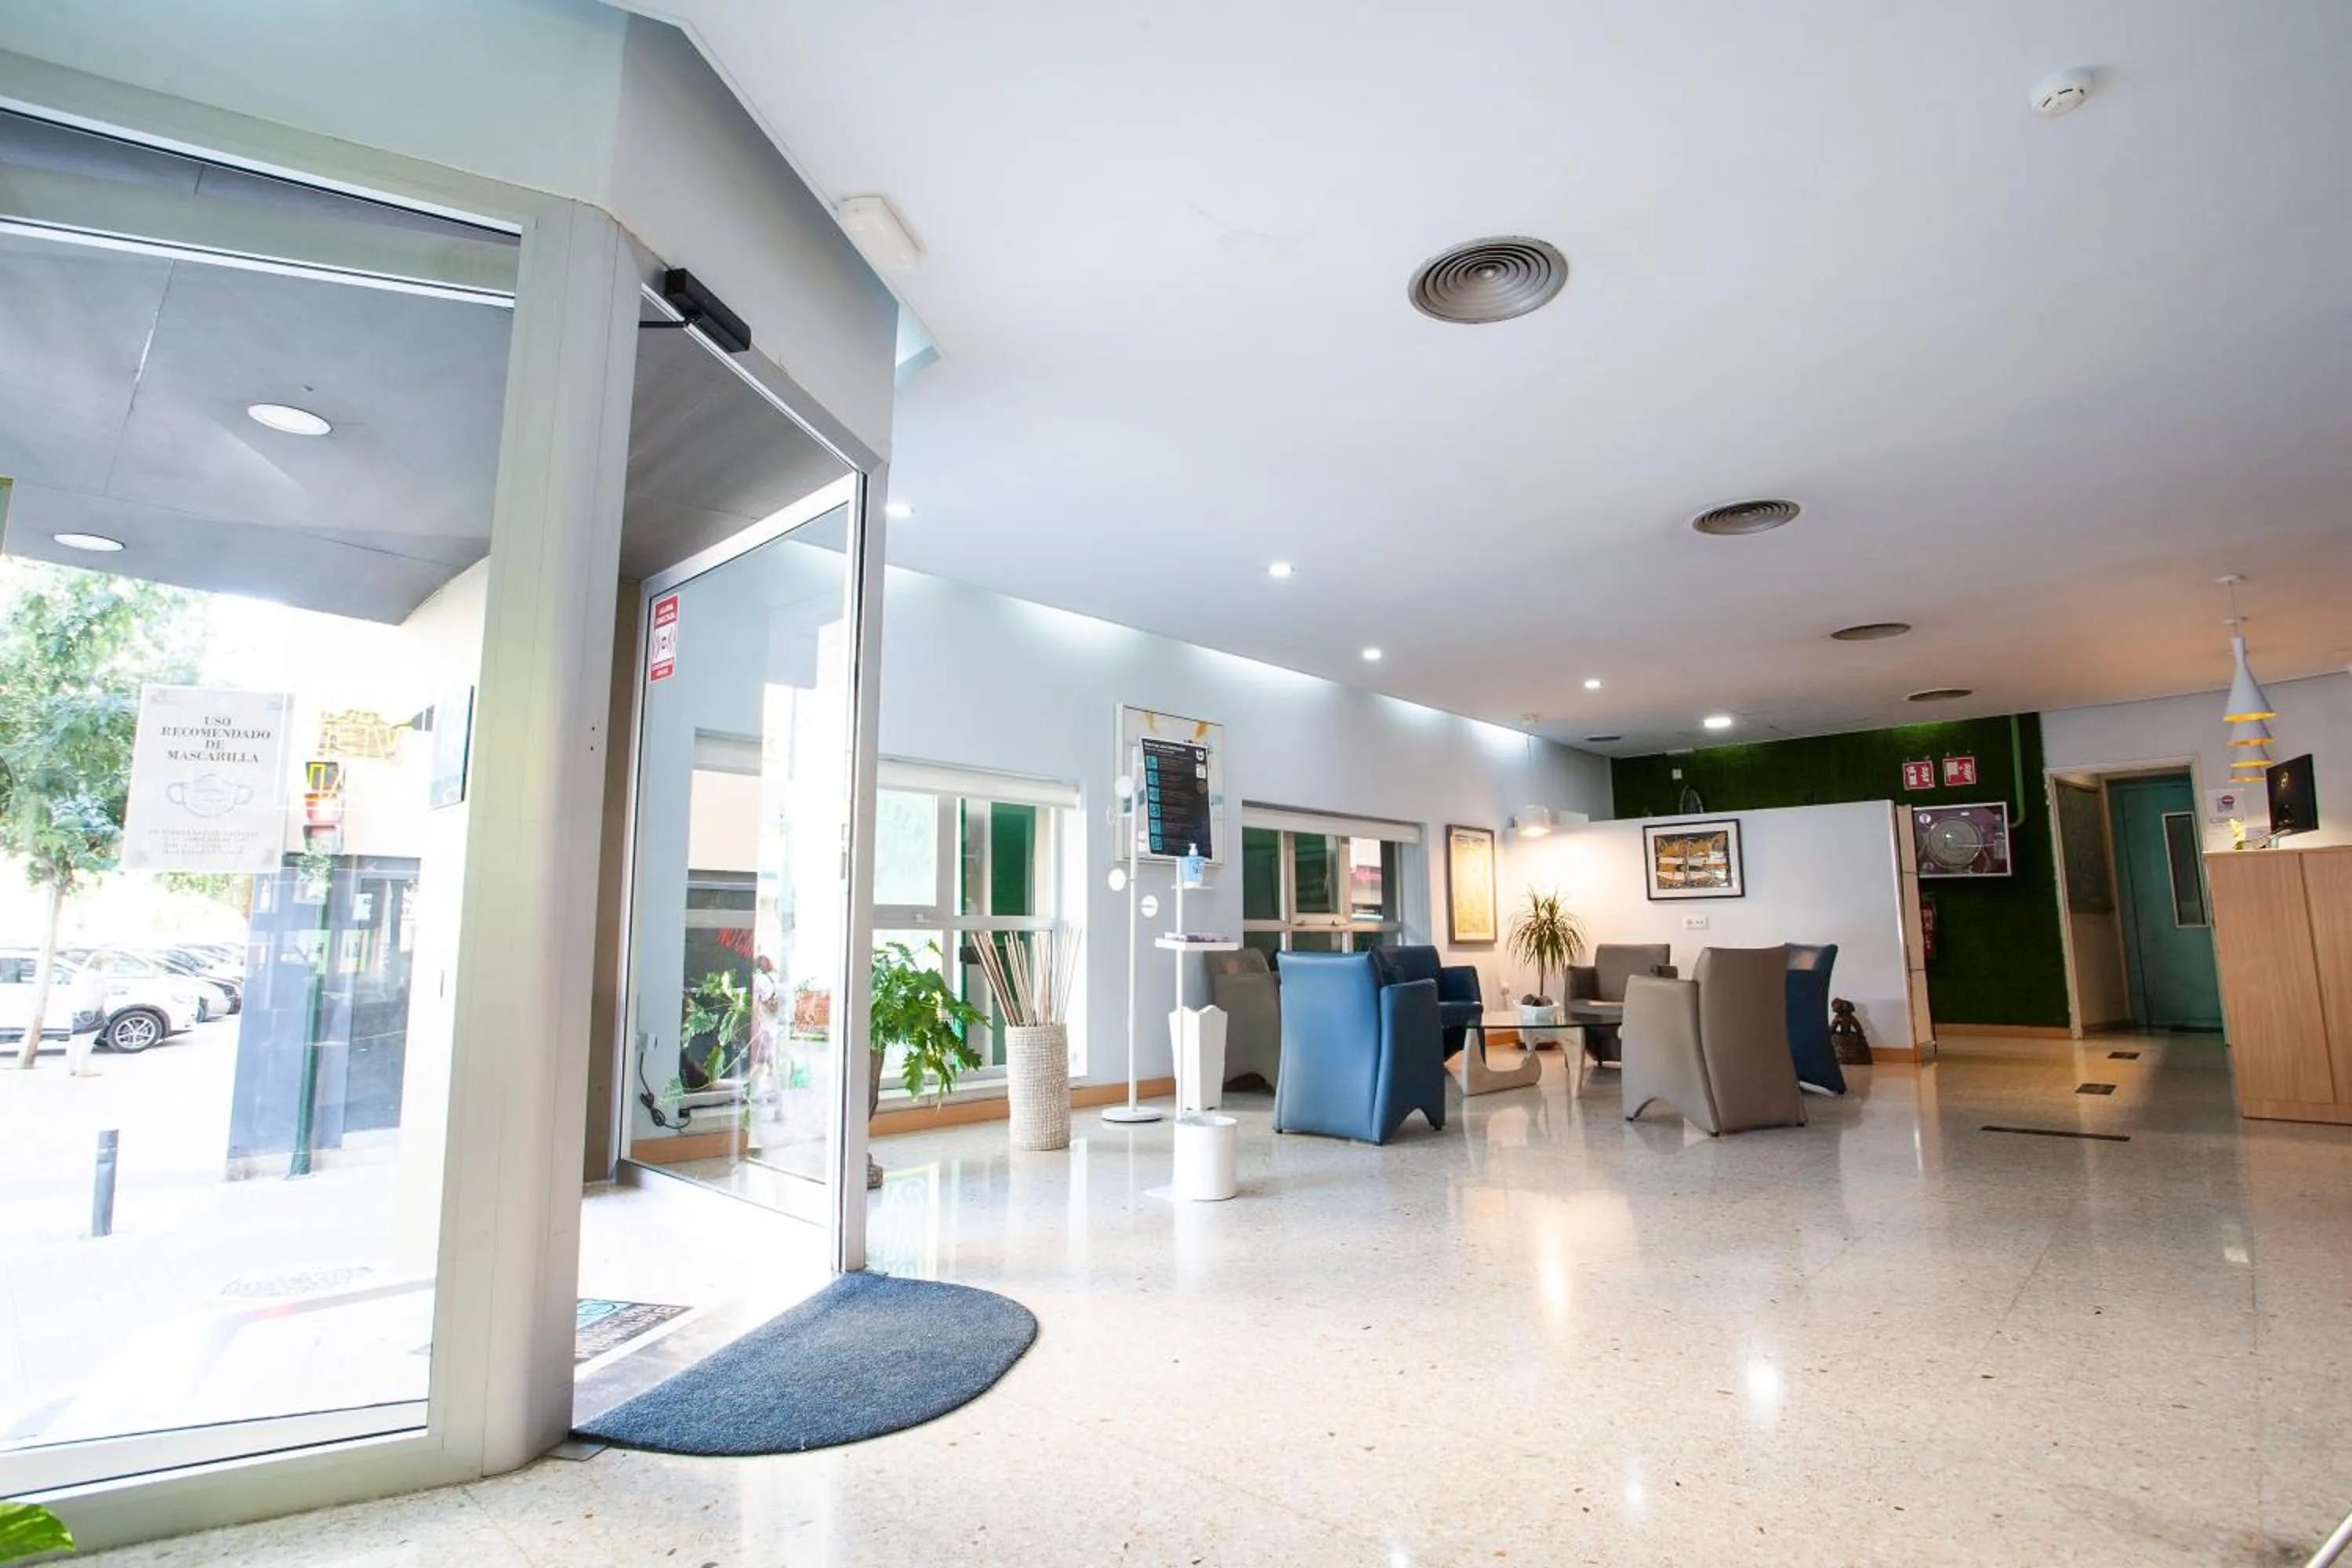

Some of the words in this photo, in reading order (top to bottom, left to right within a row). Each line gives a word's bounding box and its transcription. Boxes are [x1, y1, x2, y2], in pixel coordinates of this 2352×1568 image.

[204, 716, 231, 727] USO
[161, 727, 271, 739] RECOMENDADO
[205, 739, 225, 750] DE
[167, 750, 260, 764] MASCARILLA
